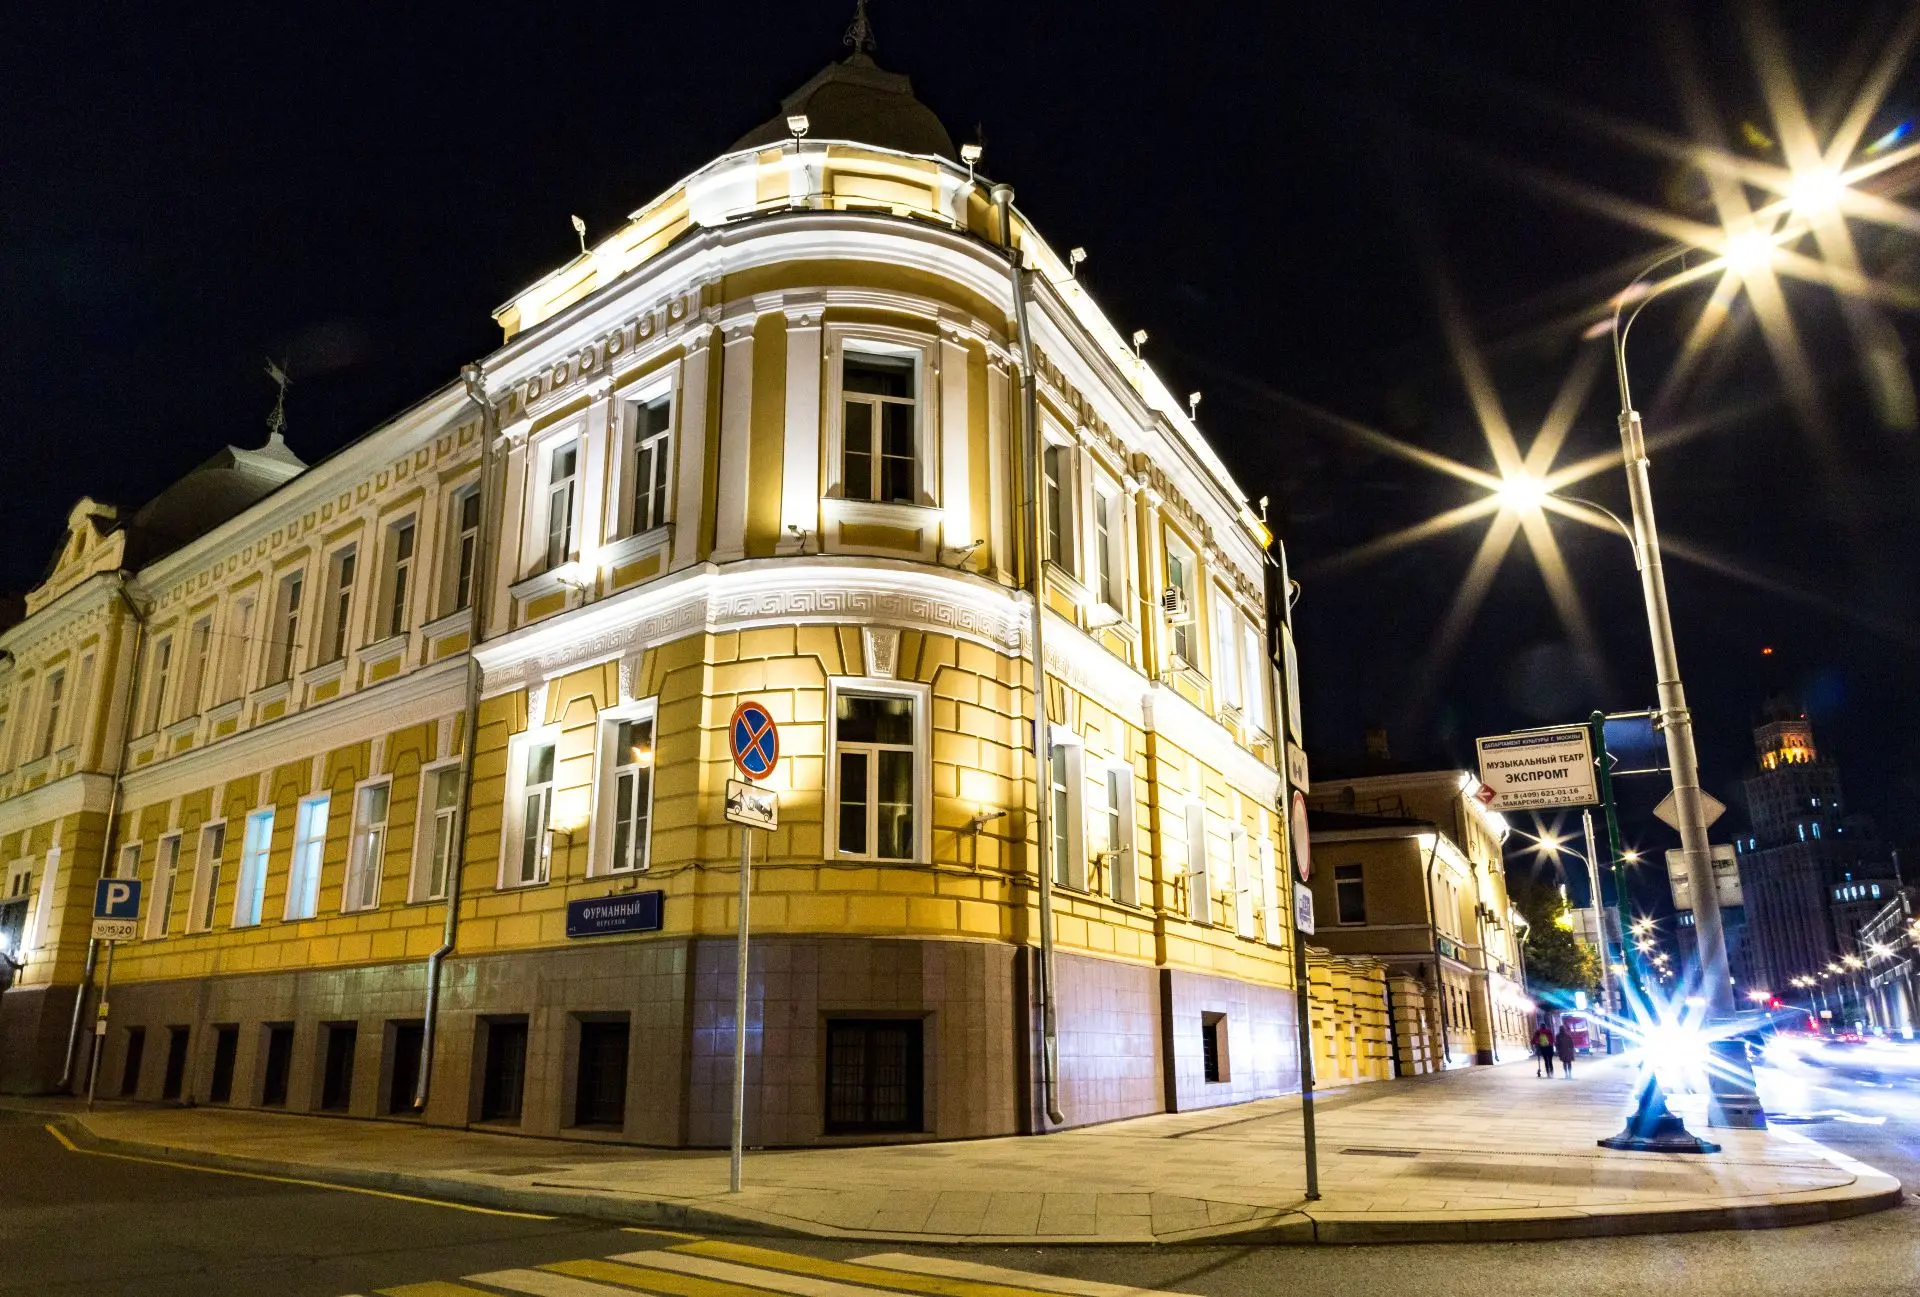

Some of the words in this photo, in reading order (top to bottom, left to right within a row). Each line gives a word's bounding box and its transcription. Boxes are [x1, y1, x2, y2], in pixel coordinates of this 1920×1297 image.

[1486, 755, 1557, 769] МУЗЫКАЛЬНЫЙ
[1558, 753, 1584, 763] ТЕАТР
[1505, 768, 1569, 783] ЭКСПРОМТ
[583, 900, 641, 919] ФУРМАННЫЙ
[107, 925, 116, 933] 15
[119, 926, 132, 935] 20
[596, 919, 626, 927] ПЕРЕУЛОК
